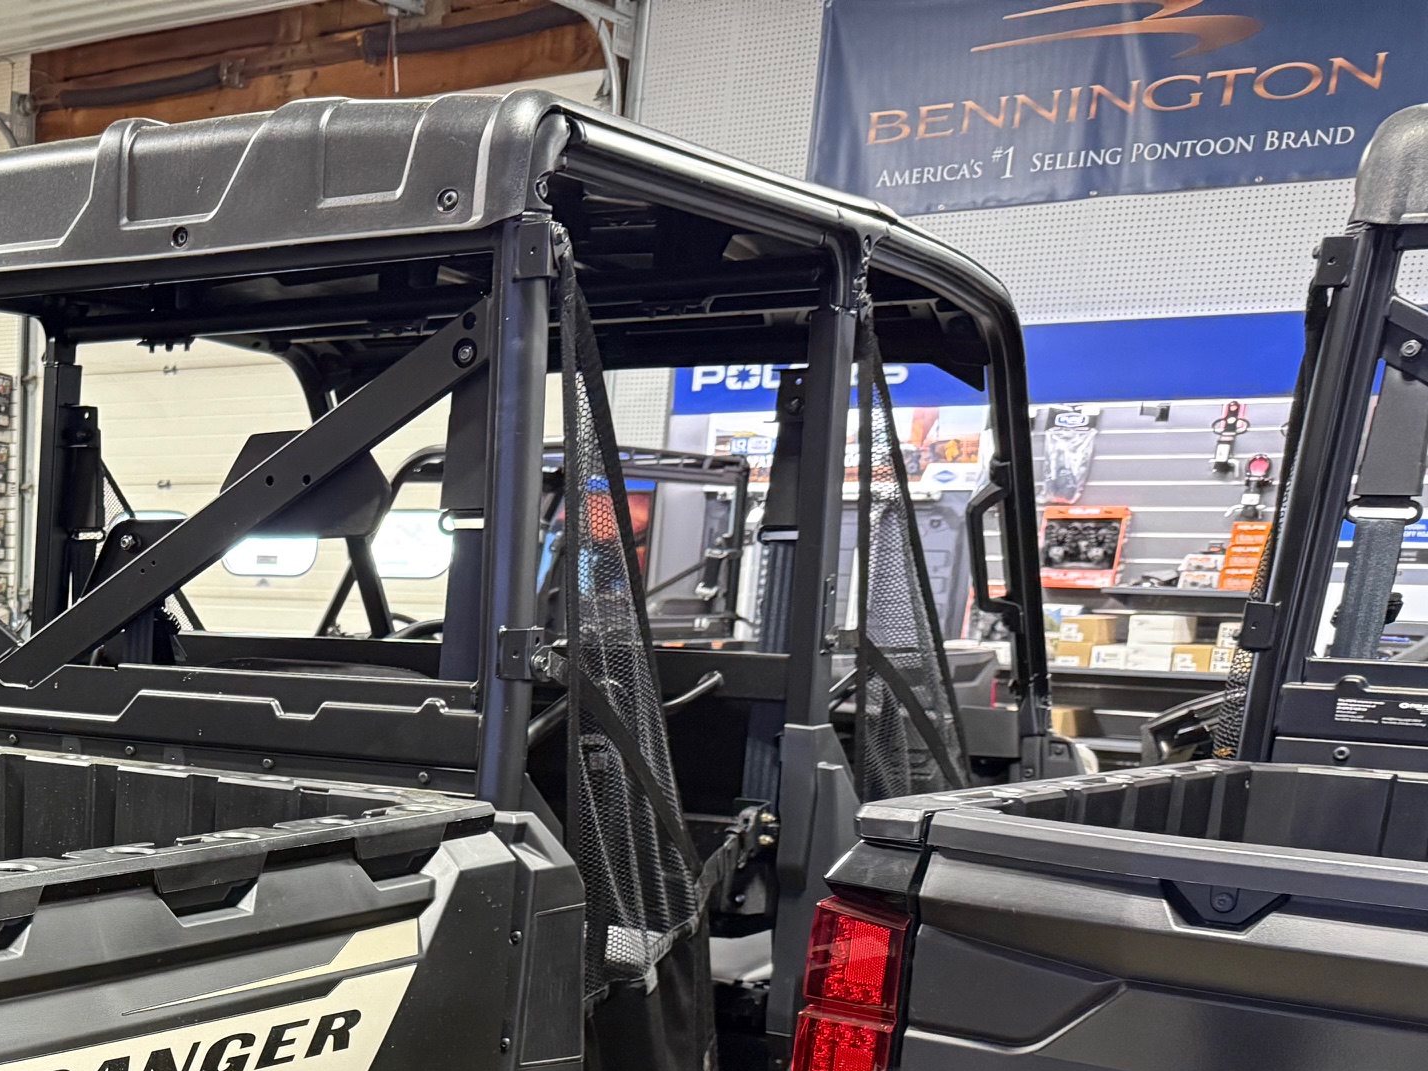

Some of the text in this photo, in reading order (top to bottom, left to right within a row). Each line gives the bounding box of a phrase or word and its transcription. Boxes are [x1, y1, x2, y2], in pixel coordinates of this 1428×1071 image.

[867, 52, 1389, 146] BENNINGTON
[991, 145, 1015, 181] #1
[1030, 146, 1123, 173] SELLING
[1130, 134, 1255, 164] PONTOON
[1264, 125, 1356, 152] BRAND
